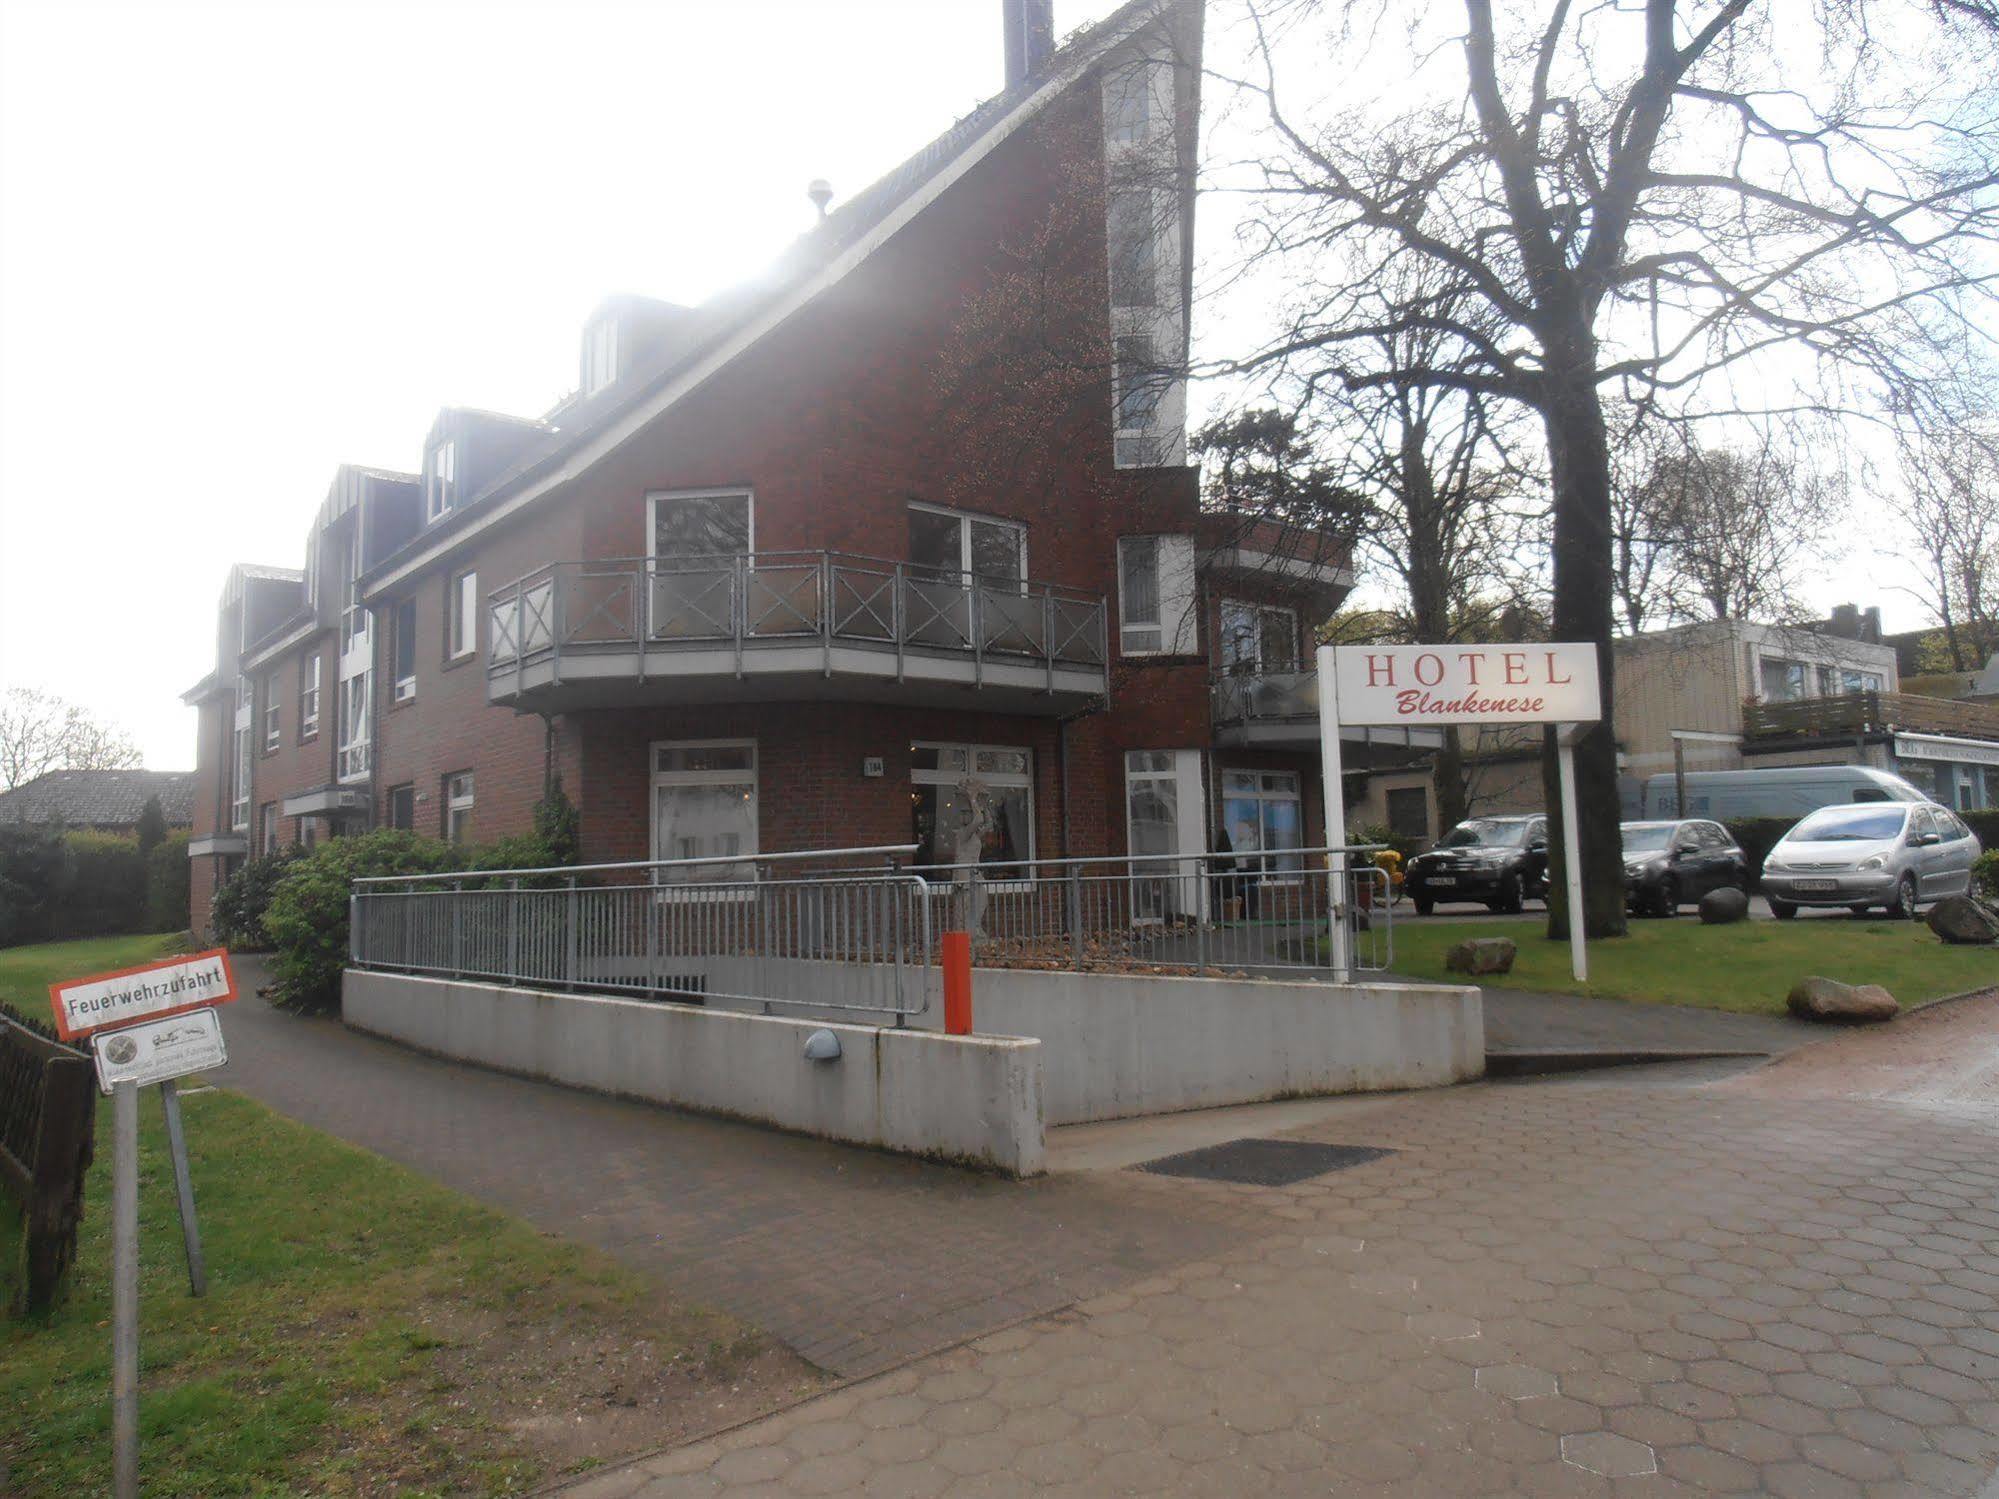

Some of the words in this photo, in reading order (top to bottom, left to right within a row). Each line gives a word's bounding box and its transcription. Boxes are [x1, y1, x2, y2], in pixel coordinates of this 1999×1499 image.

[1365, 652, 1572, 687] HOTEL
[1395, 689, 1545, 715] Blankenese
[68, 967, 222, 1016] Feuerwehrzufahrt
